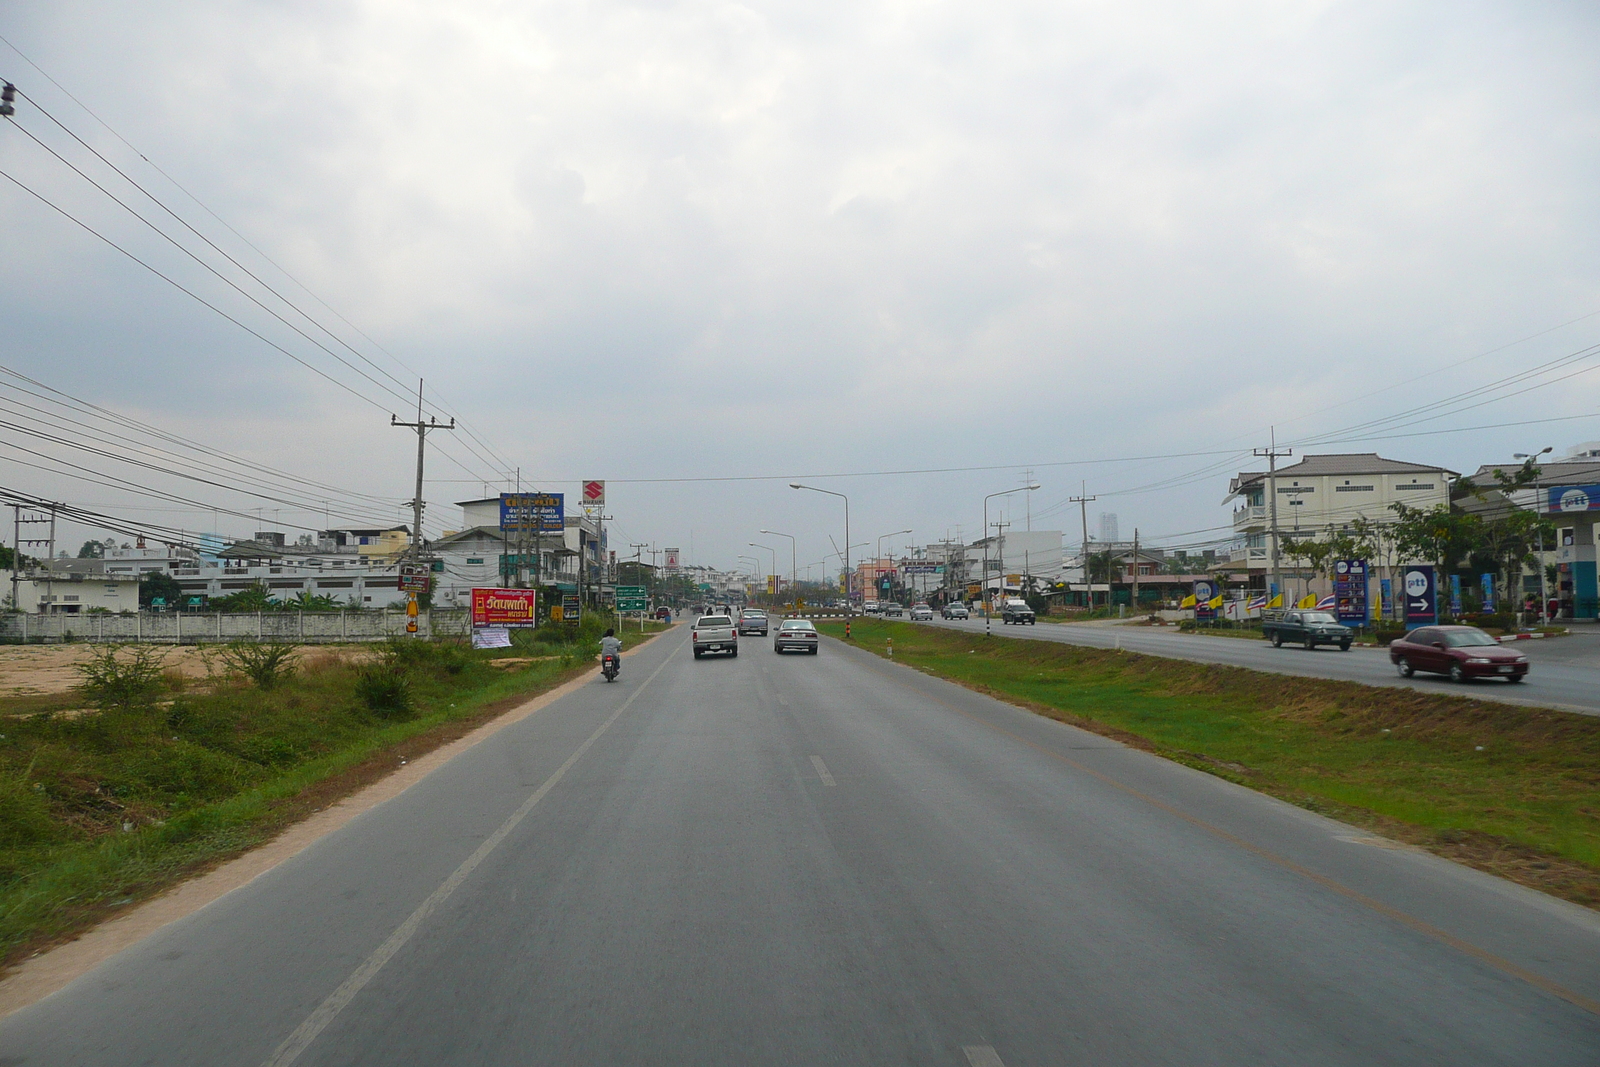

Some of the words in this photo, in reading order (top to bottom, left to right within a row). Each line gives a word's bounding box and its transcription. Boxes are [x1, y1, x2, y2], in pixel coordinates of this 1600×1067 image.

[1565, 496, 1586, 508] ptt
[1408, 578, 1426, 589] ptt
[1197, 588, 1210, 596] ptt
